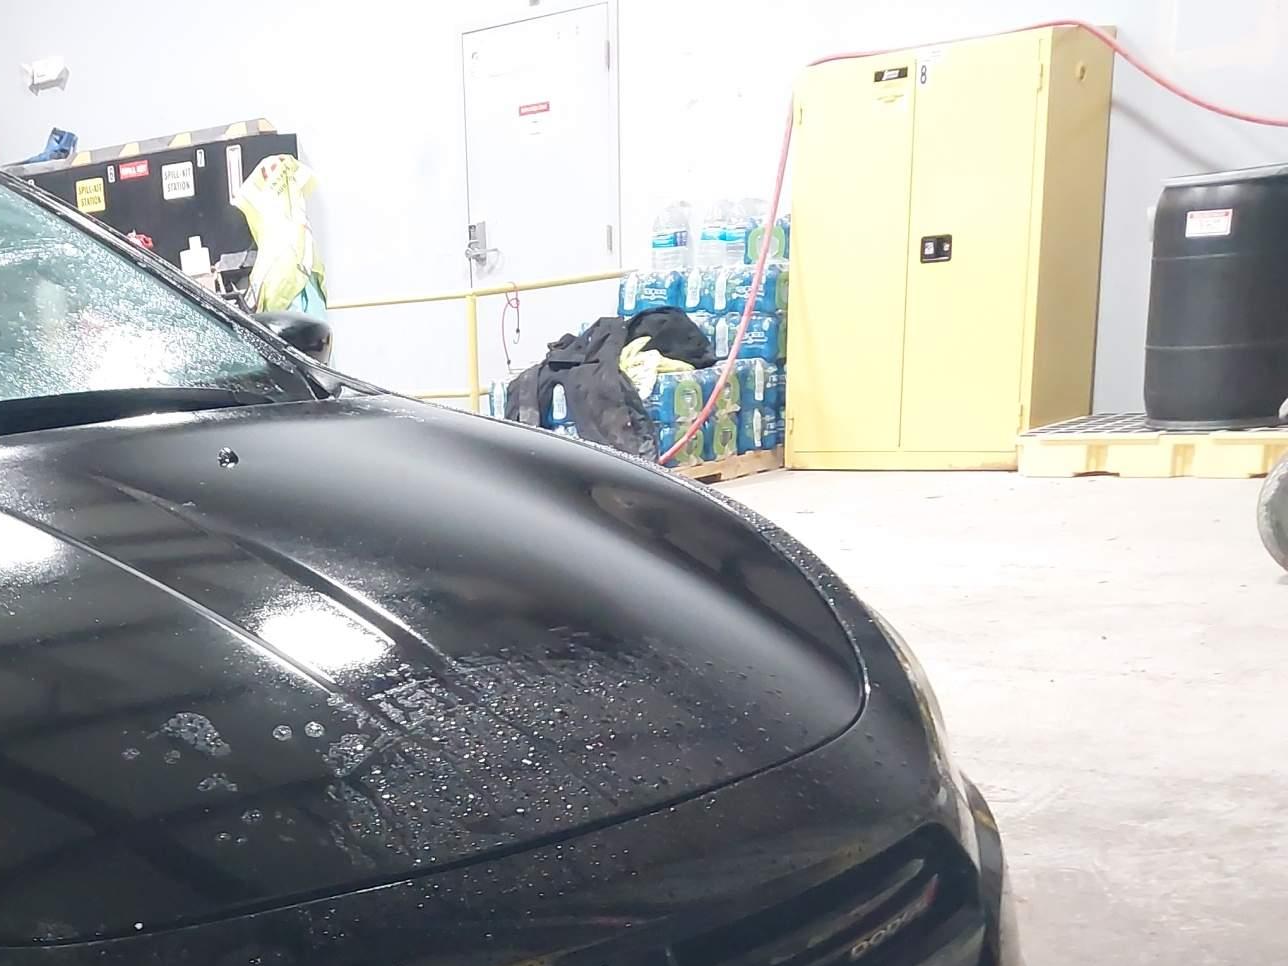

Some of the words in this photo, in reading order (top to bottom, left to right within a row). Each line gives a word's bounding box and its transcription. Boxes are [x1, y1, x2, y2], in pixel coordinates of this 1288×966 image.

[920, 65, 927, 84] 8
[167, 181, 191, 192] STATION
[81, 197, 102, 208] STATION
